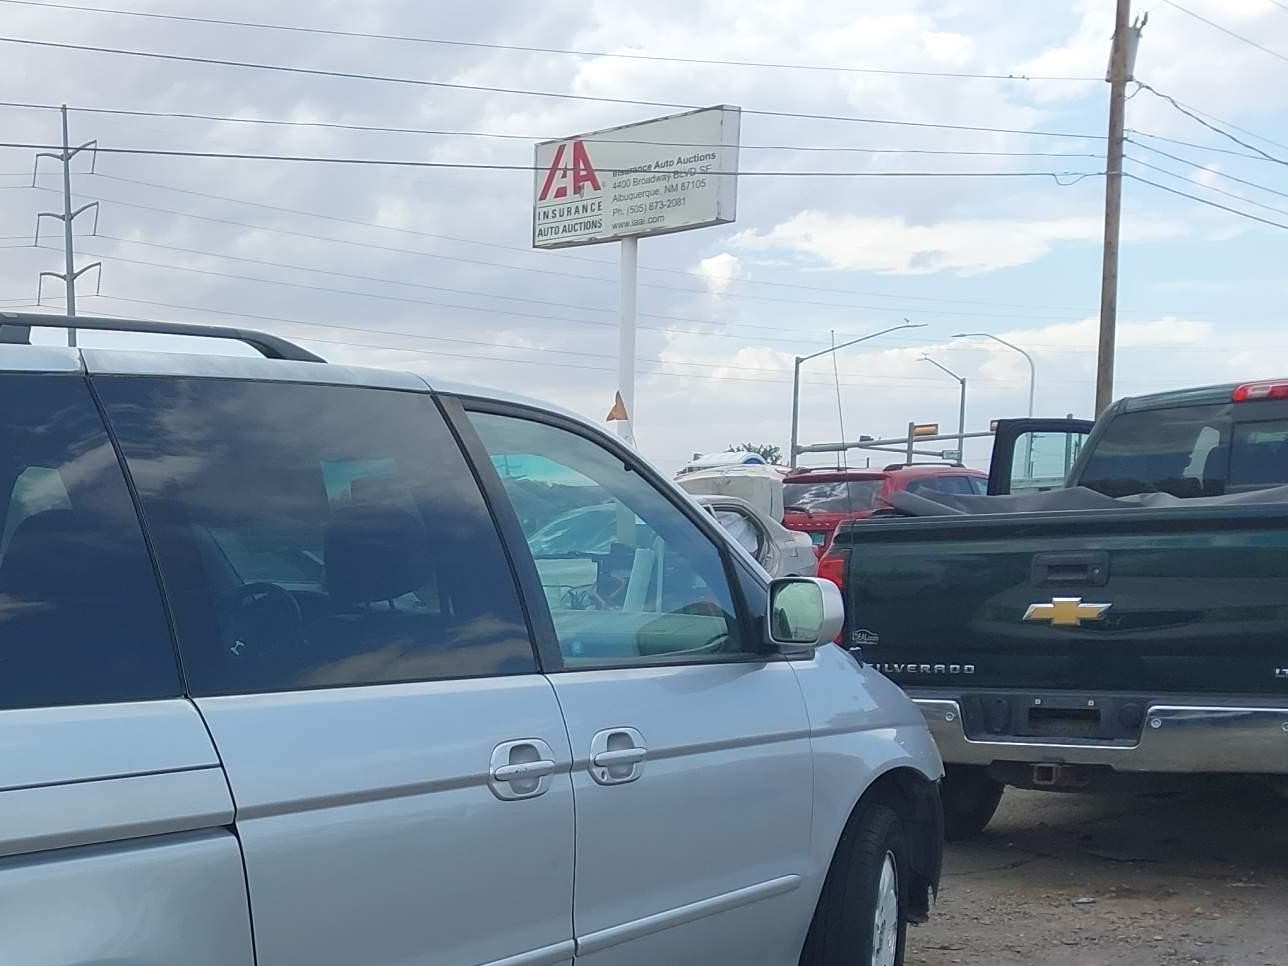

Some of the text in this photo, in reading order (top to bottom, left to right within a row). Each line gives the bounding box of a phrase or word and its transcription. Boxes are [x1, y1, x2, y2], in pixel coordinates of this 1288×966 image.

[654, 159, 675, 169] Auto
[676, 152, 716, 166] Auctions
[664, 183, 678, 194] NM
[538, 201, 603, 221] INSURANCE
[537, 218, 603, 238] AUTO AUCTIONS
